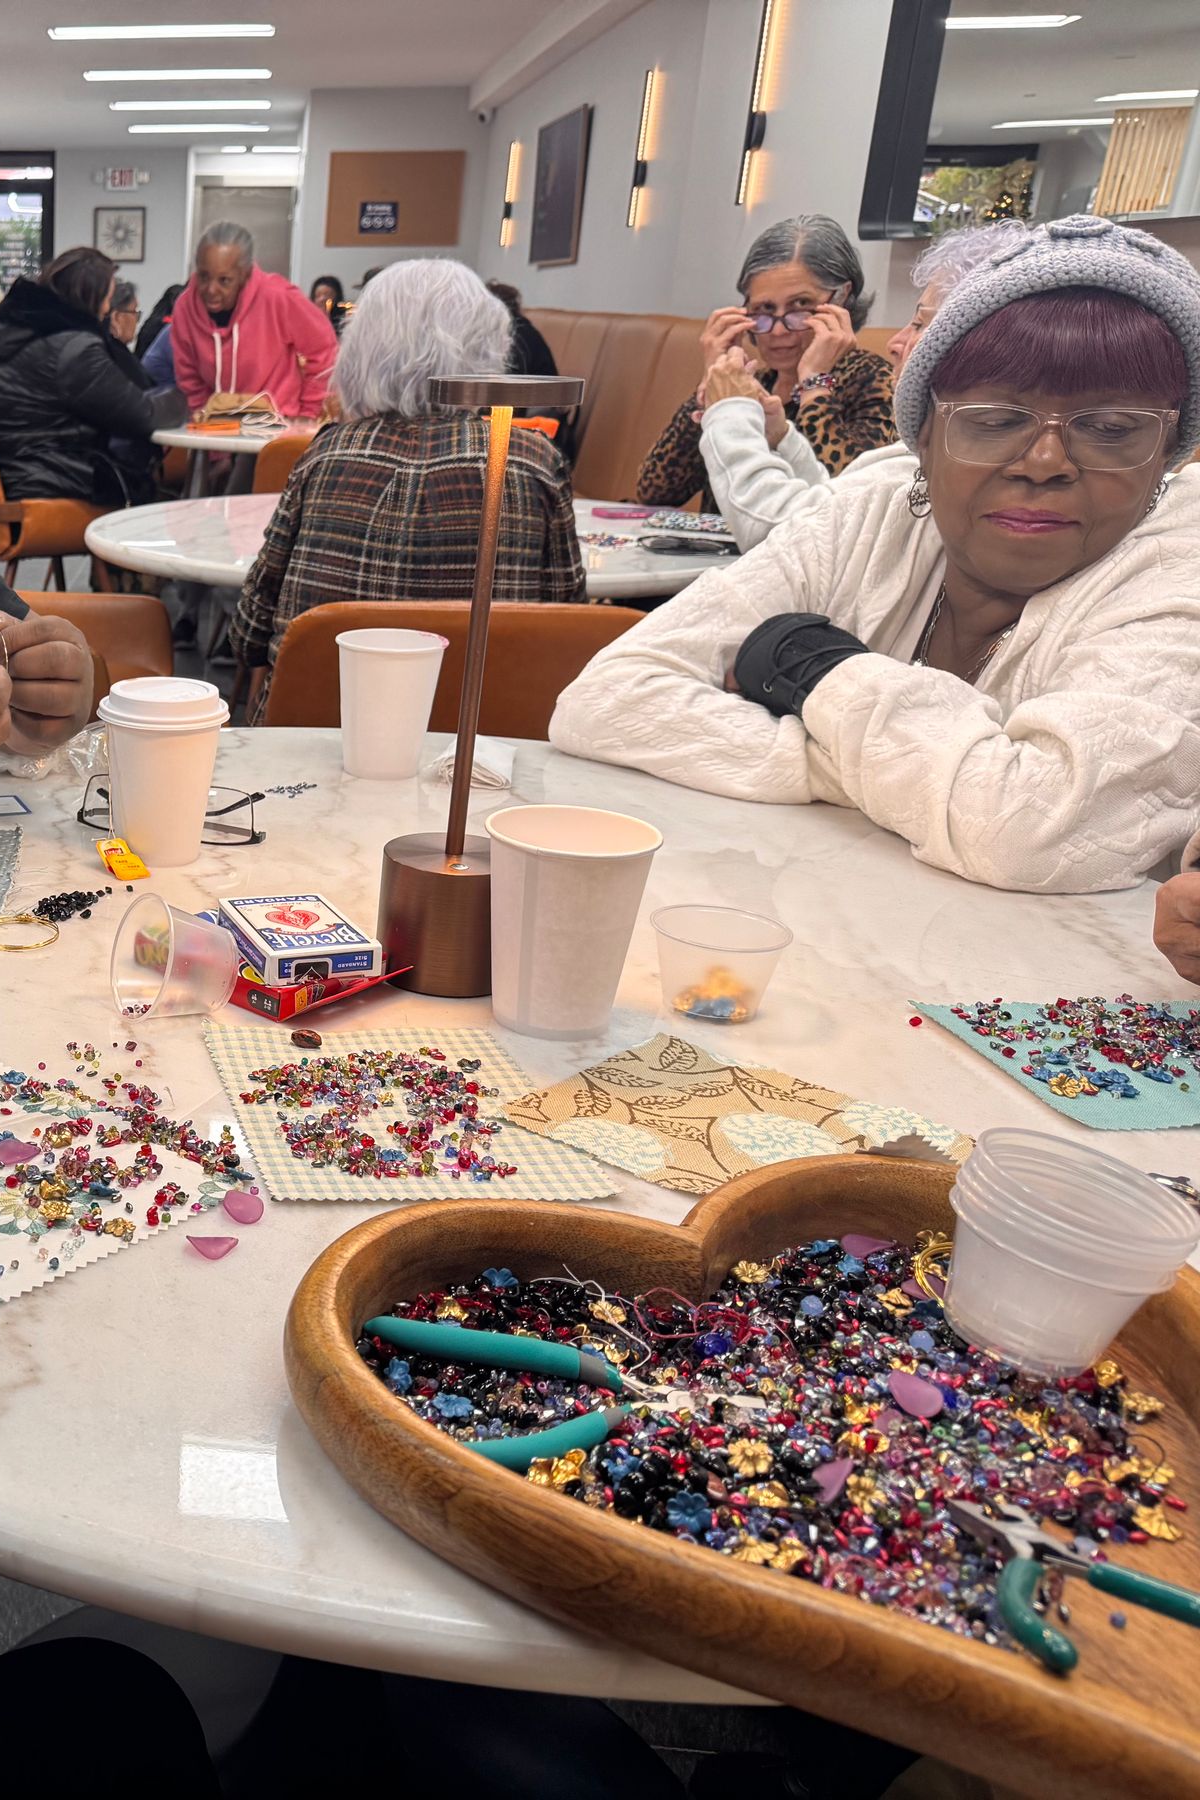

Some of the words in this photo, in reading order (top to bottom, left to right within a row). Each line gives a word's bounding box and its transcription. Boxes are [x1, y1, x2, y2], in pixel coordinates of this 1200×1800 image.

[111, 169, 134, 187] EXIT
[233, 895, 318, 906] STANDARD
[261, 926, 361, 950] BICYCLE
[337, 960, 368, 969] STANDARD
